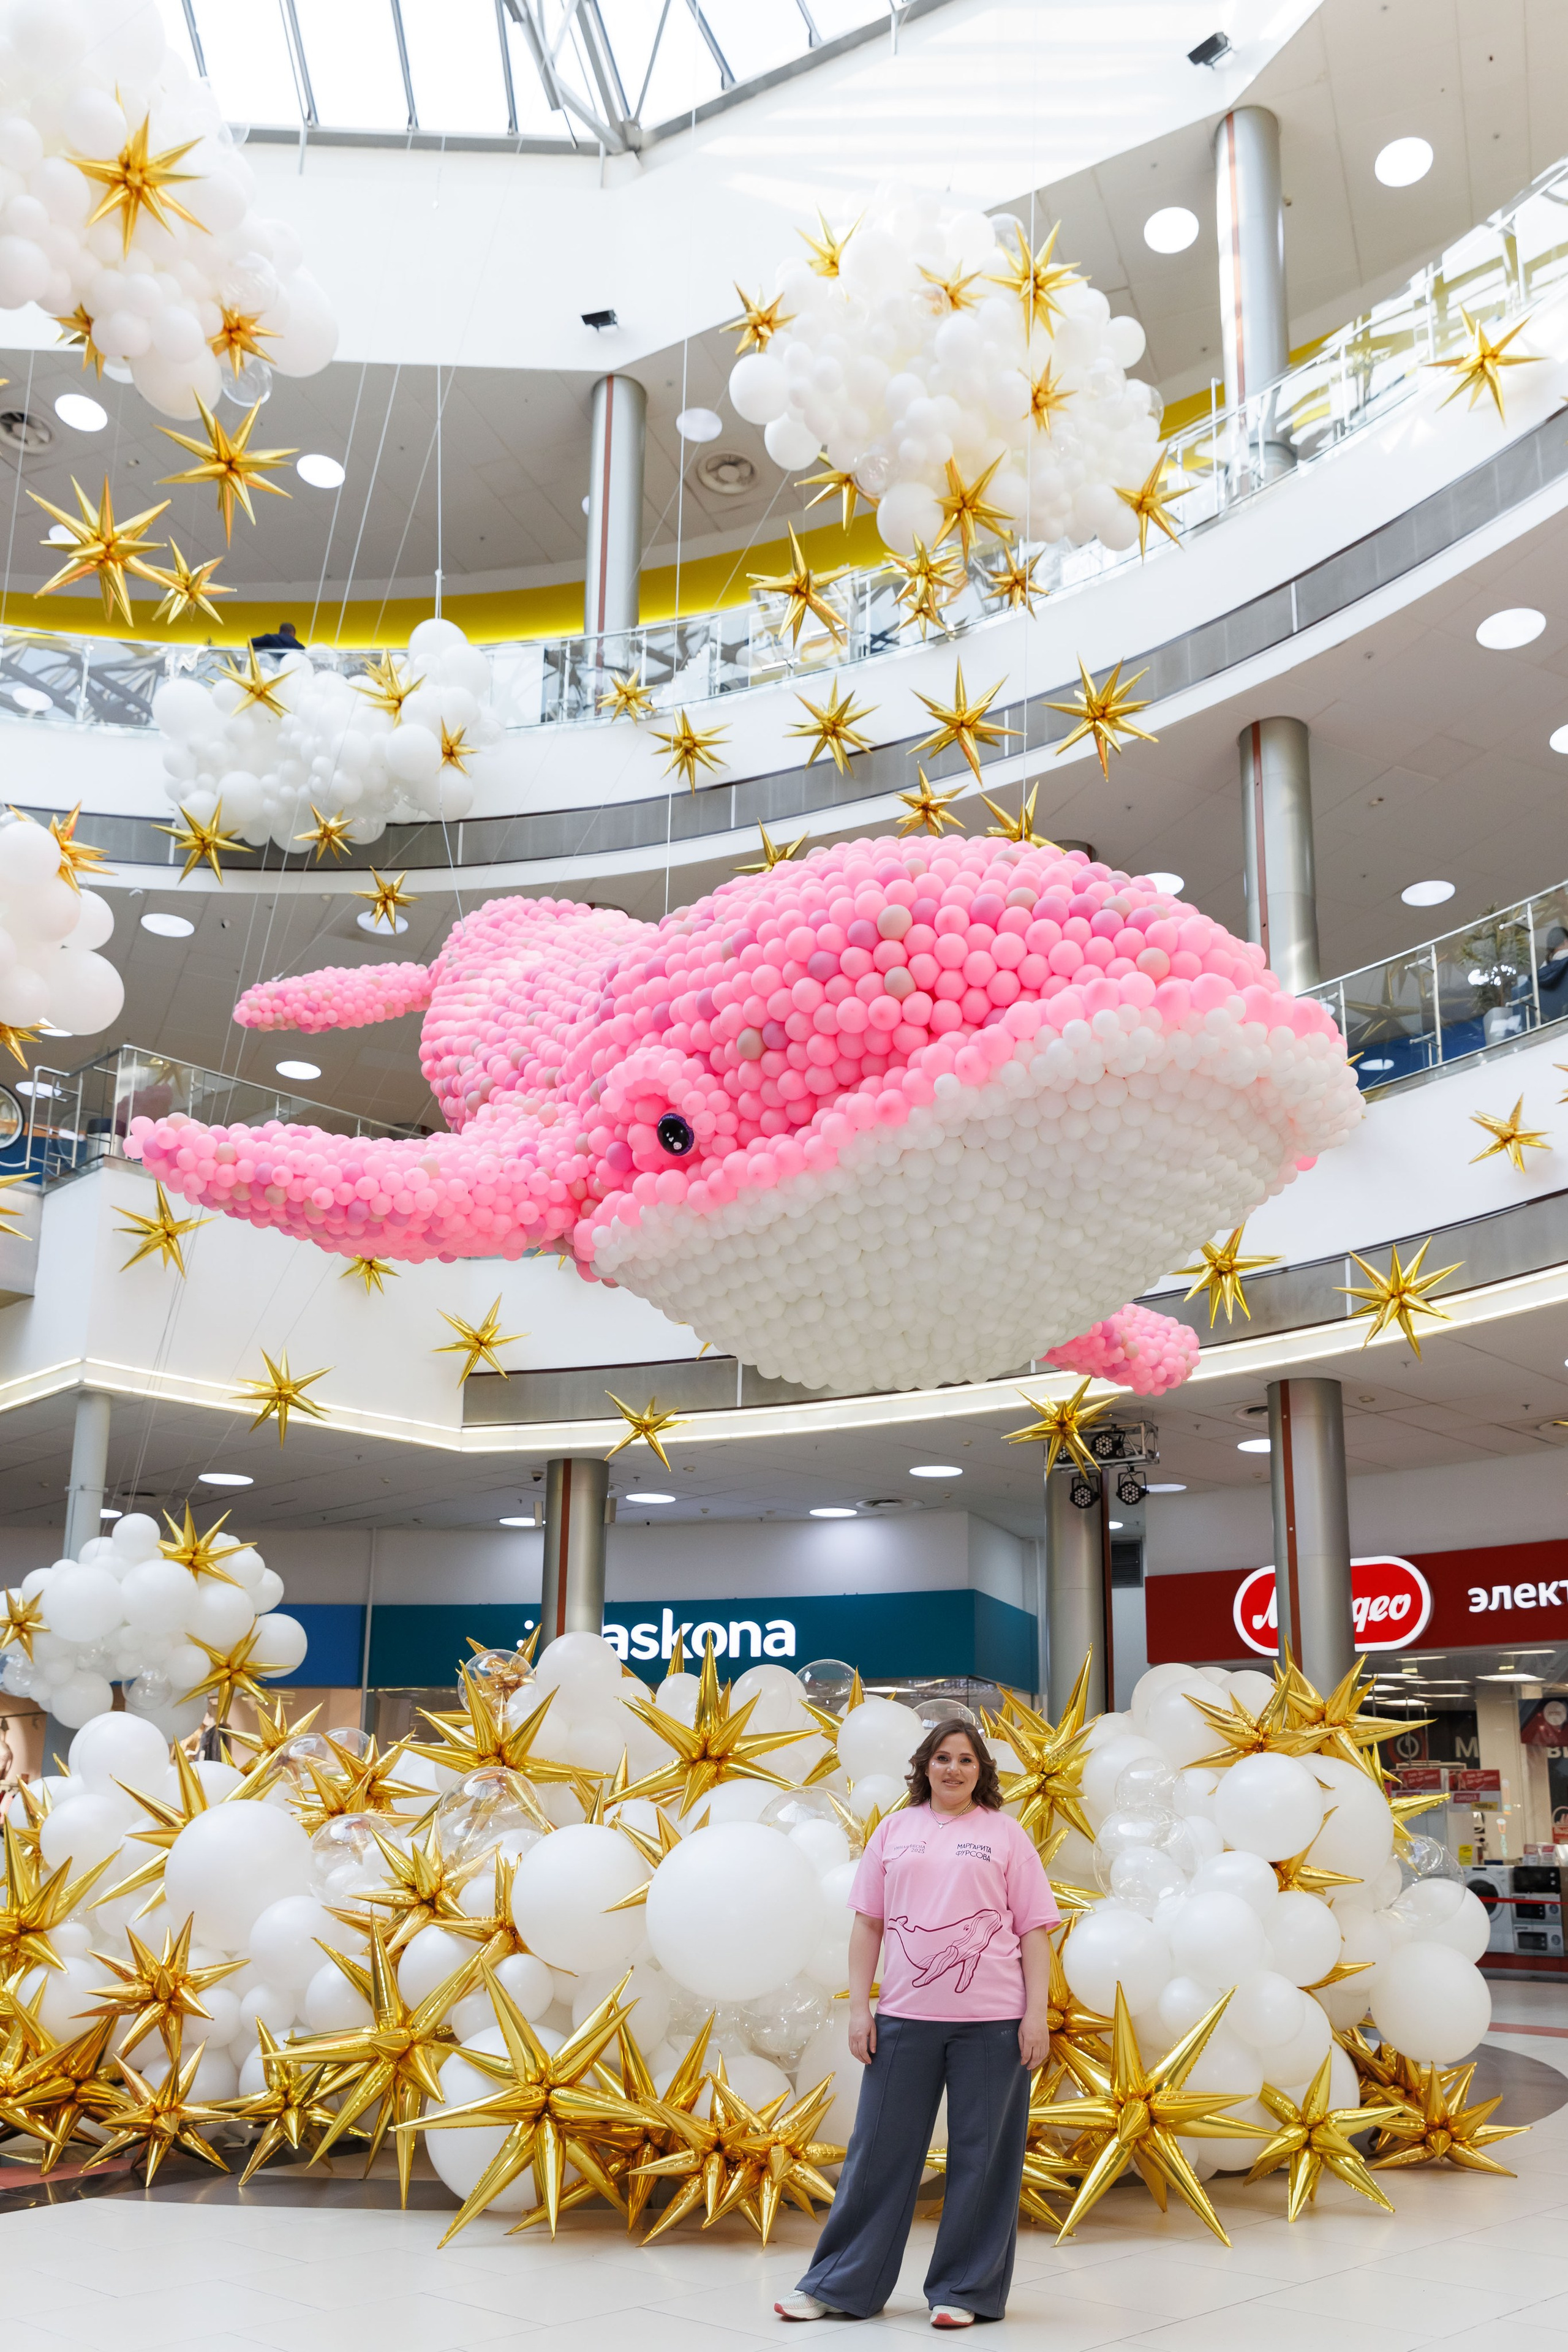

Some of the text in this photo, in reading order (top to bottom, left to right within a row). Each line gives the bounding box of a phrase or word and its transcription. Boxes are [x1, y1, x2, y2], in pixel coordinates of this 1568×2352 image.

[601, 1608, 796, 1660] askona
[957, 1842, 992, 1854] МАРГАРИТА
[956, 1850, 991, 1863] ФУРСОВА
